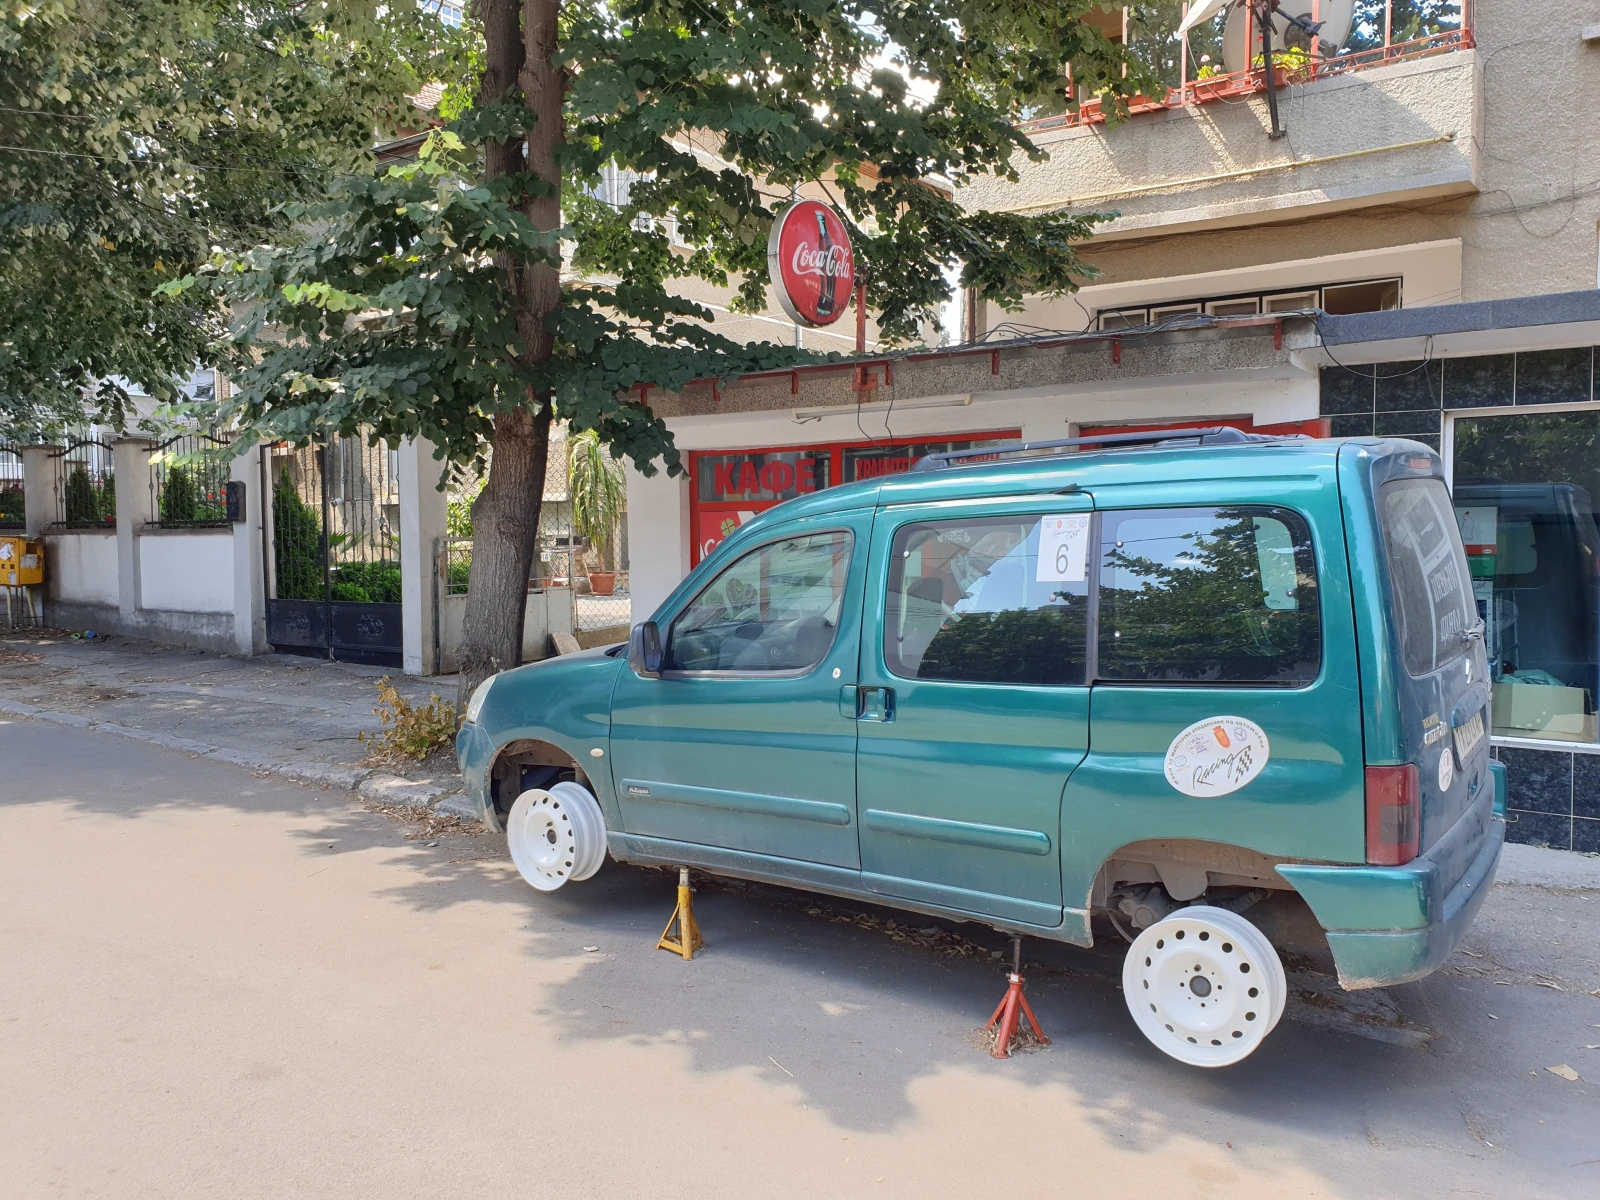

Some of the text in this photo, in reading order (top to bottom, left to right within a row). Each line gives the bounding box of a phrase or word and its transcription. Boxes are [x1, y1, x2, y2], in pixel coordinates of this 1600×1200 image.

[792, 242, 851, 279] Coca-Cola
[714, 458, 816, 495] КАФЕ
[1056, 543, 1069, 574] 6
[1193, 748, 1246, 790] Racing
